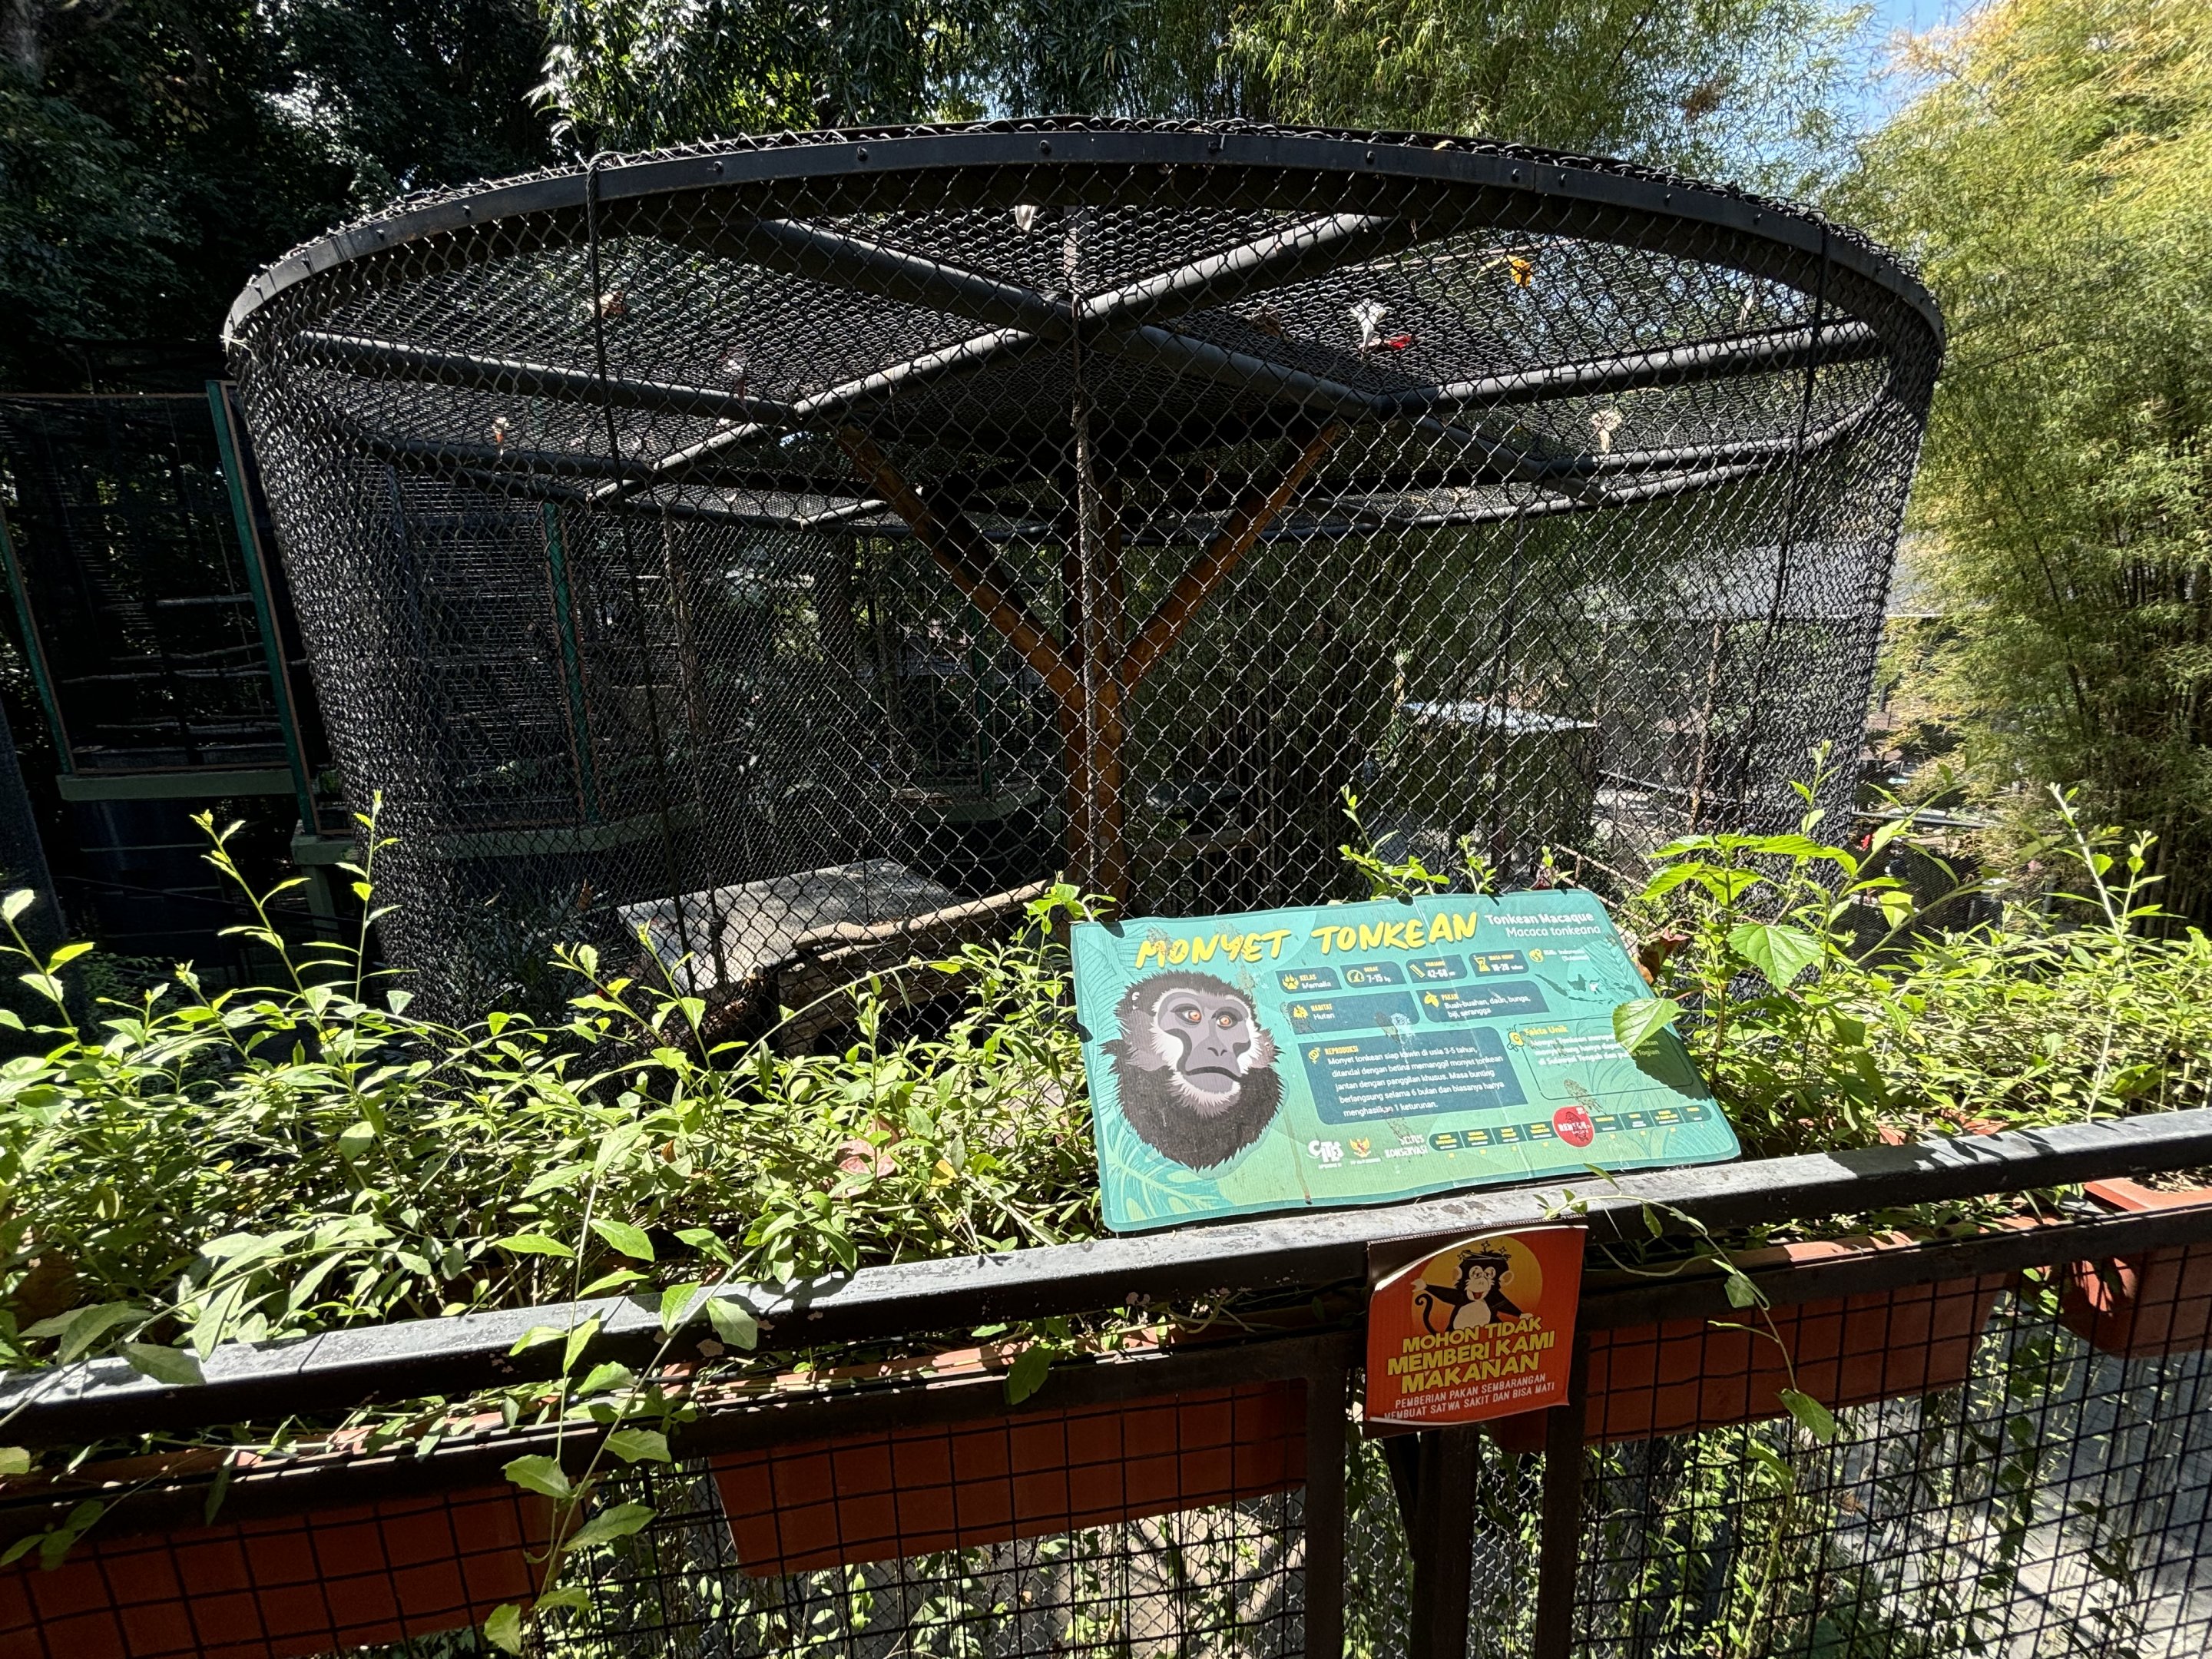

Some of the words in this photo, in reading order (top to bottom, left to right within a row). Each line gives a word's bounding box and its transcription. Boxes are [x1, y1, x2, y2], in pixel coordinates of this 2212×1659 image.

[1485, 913, 1537, 926] Tonkean
[1538, 912, 1594, 925] Macaque
[1135, 929, 1292, 969] MONYET
[1310, 911, 1478, 954] TONKEAN
[1505, 926, 1548, 938] Macaca
[1550, 924, 1601, 936] tonkeana
[1548, 1024, 1568, 1034] Unik
[1327, 1056, 1354, 1065] Monyet
[1355, 1054, 1383, 1063] tonkean
[1384, 1051, 1399, 1061] siap
[1421, 1048, 1429, 1057] di
[1429, 1048, 1444, 1056] usia
[1637, 1048, 1661, 1058] Togian
[1332, 1067, 1361, 1078] ditandai
[1361, 1065, 1388, 1075] dengan
[1388, 1063, 1410, 1073] betina
[1411, 1059, 1449, 1070] memanggil
[1450, 1058, 1475, 1068] monyet
[1475, 1055, 1504, 1065] tonkean
[1335, 1081, 1359, 1092] jantan
[1359, 1078, 1386, 1088] dengan
[1386, 1075, 1421, 1087] panggilan
[1421, 1072, 1449, 1082] khusus.
[1449, 1071, 1469, 1081] Masa
[1469, 1068, 1495, 1079] bunting
[1339, 1092, 1383, 1104] berlangsung
[1384, 1090, 1411, 1100] selama
[1417, 1086, 1437, 1096] bulan
[1438, 1084, 1452, 1094] dan
[1452, 1082, 1484, 1093] biasanya
[1484, 1081, 1505, 1091] hanya
[1343, 1104, 1394, 1118] menghasilkan
[1399, 1101, 1438, 1111] keturunan.
[1402, 1326, 1479, 1354] MOHON
[1485, 1316, 1542, 1339] TIDAK
[1387, 1343, 1490, 1376] MEMBERI
[1495, 1330, 1555, 1358] KAMI
[1401, 1352, 1540, 1395] MAKANAN
[1395, 1393, 1447, 1409] PEMBERIAN
[1449, 1387, 1479, 1399] PAKAN
[1482, 1373, 1546, 1393] SEMBARANGAN
[1430, 1399, 1460, 1415] SATWA
[1463, 1394, 1489, 1408] SAKIT
[1492, 1390, 1510, 1403] DAN
[1512, 1386, 1532, 1399] BISA
[1535, 1381, 1555, 1395] MATI
